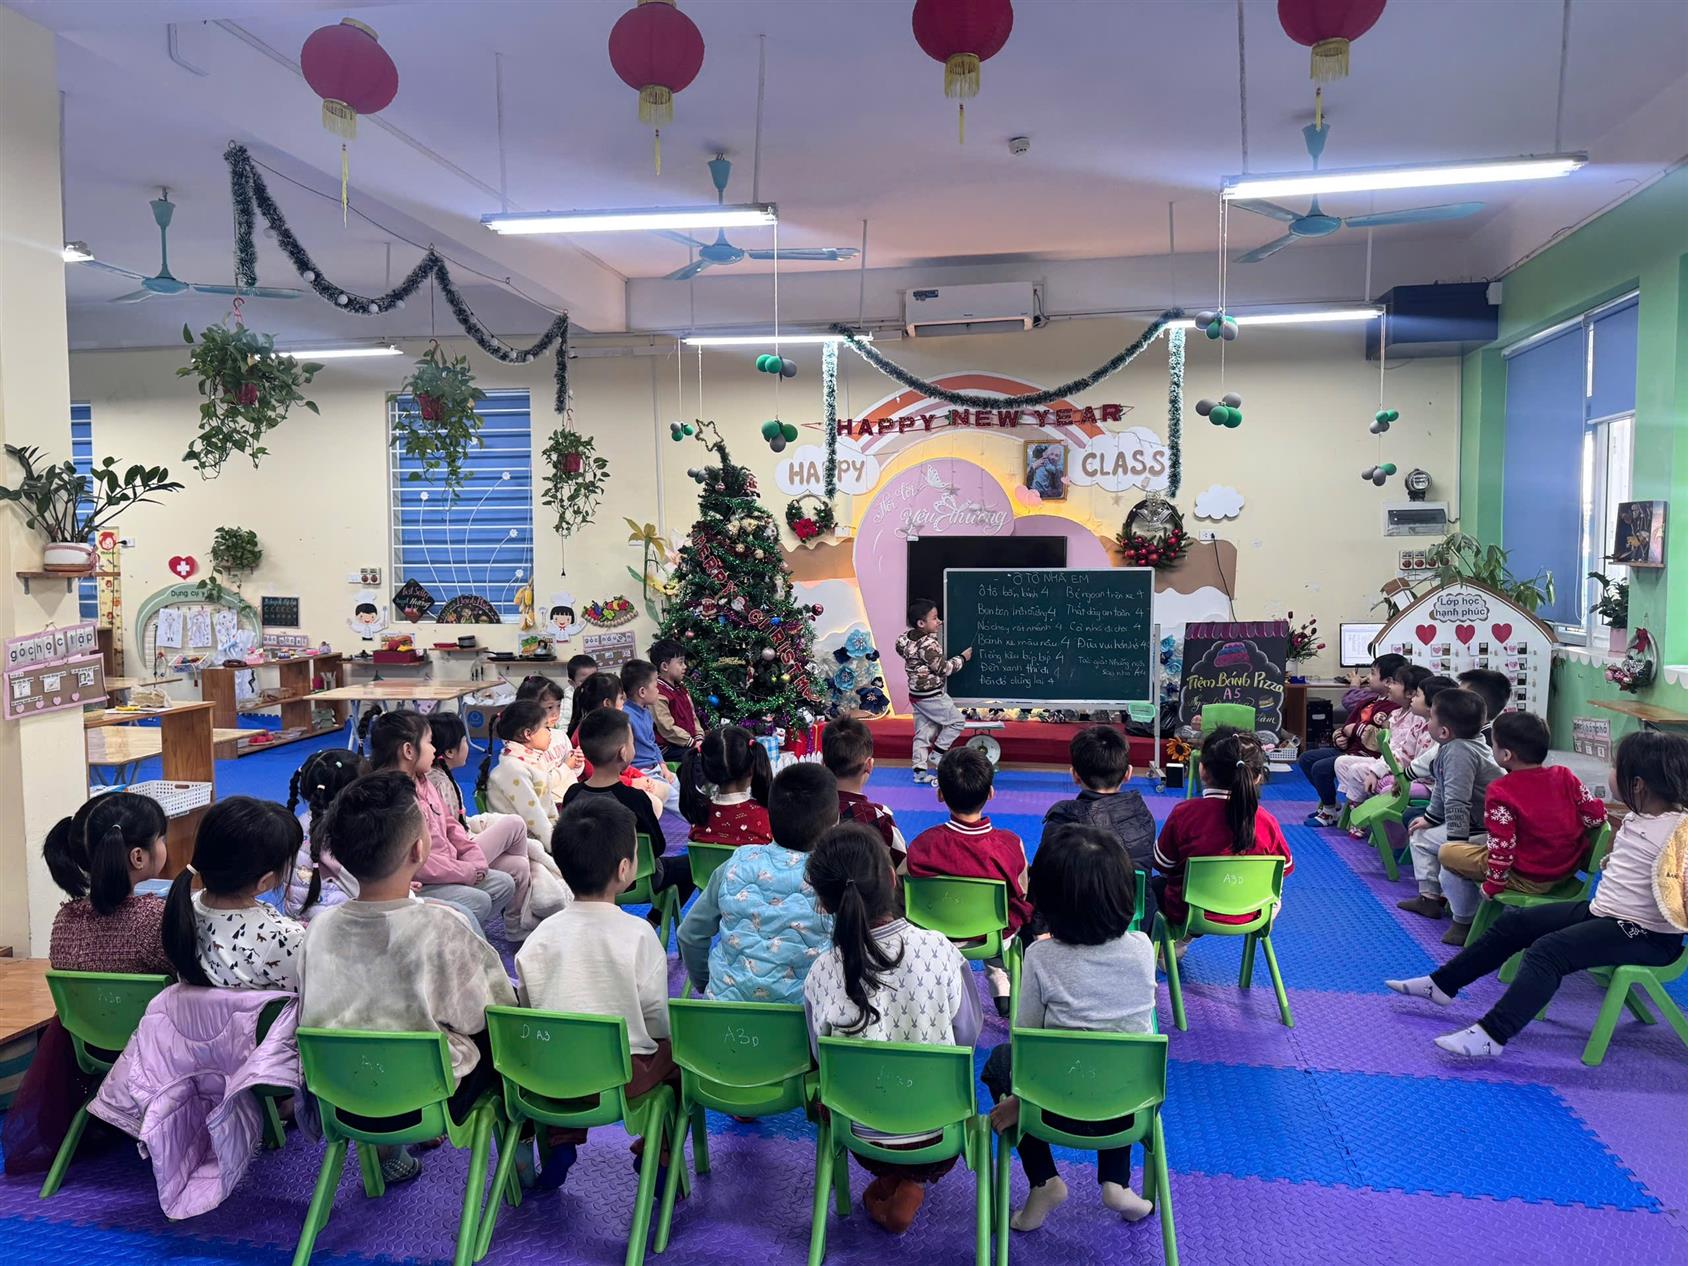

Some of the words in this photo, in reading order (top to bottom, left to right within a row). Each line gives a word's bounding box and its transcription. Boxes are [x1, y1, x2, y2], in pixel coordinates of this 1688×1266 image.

[836, 414, 936, 437] HAPPY
[951, 408, 1020, 428] NEW
[1033, 404, 1122, 427] YEAR
[1081, 450, 1166, 478] CLASS
[788, 459, 865, 486] HAPY
[1071, 574, 1089, 584] EM
[1440, 597, 1460, 607] Lớp
[1462, 597, 1480, 606] học
[1435, 608, 1459, 618] hạnh
[1461, 608, 1486, 618] phúc
[1060, 635, 1071, 649] 4
[1055, 652, 1065, 664] 4
[1186, 674, 1216, 691] Tiệm
[1216, 671, 1250, 687] Bánh
[1253, 671, 1284, 693] Pizza
[1223, 687, 1241, 700] A5
